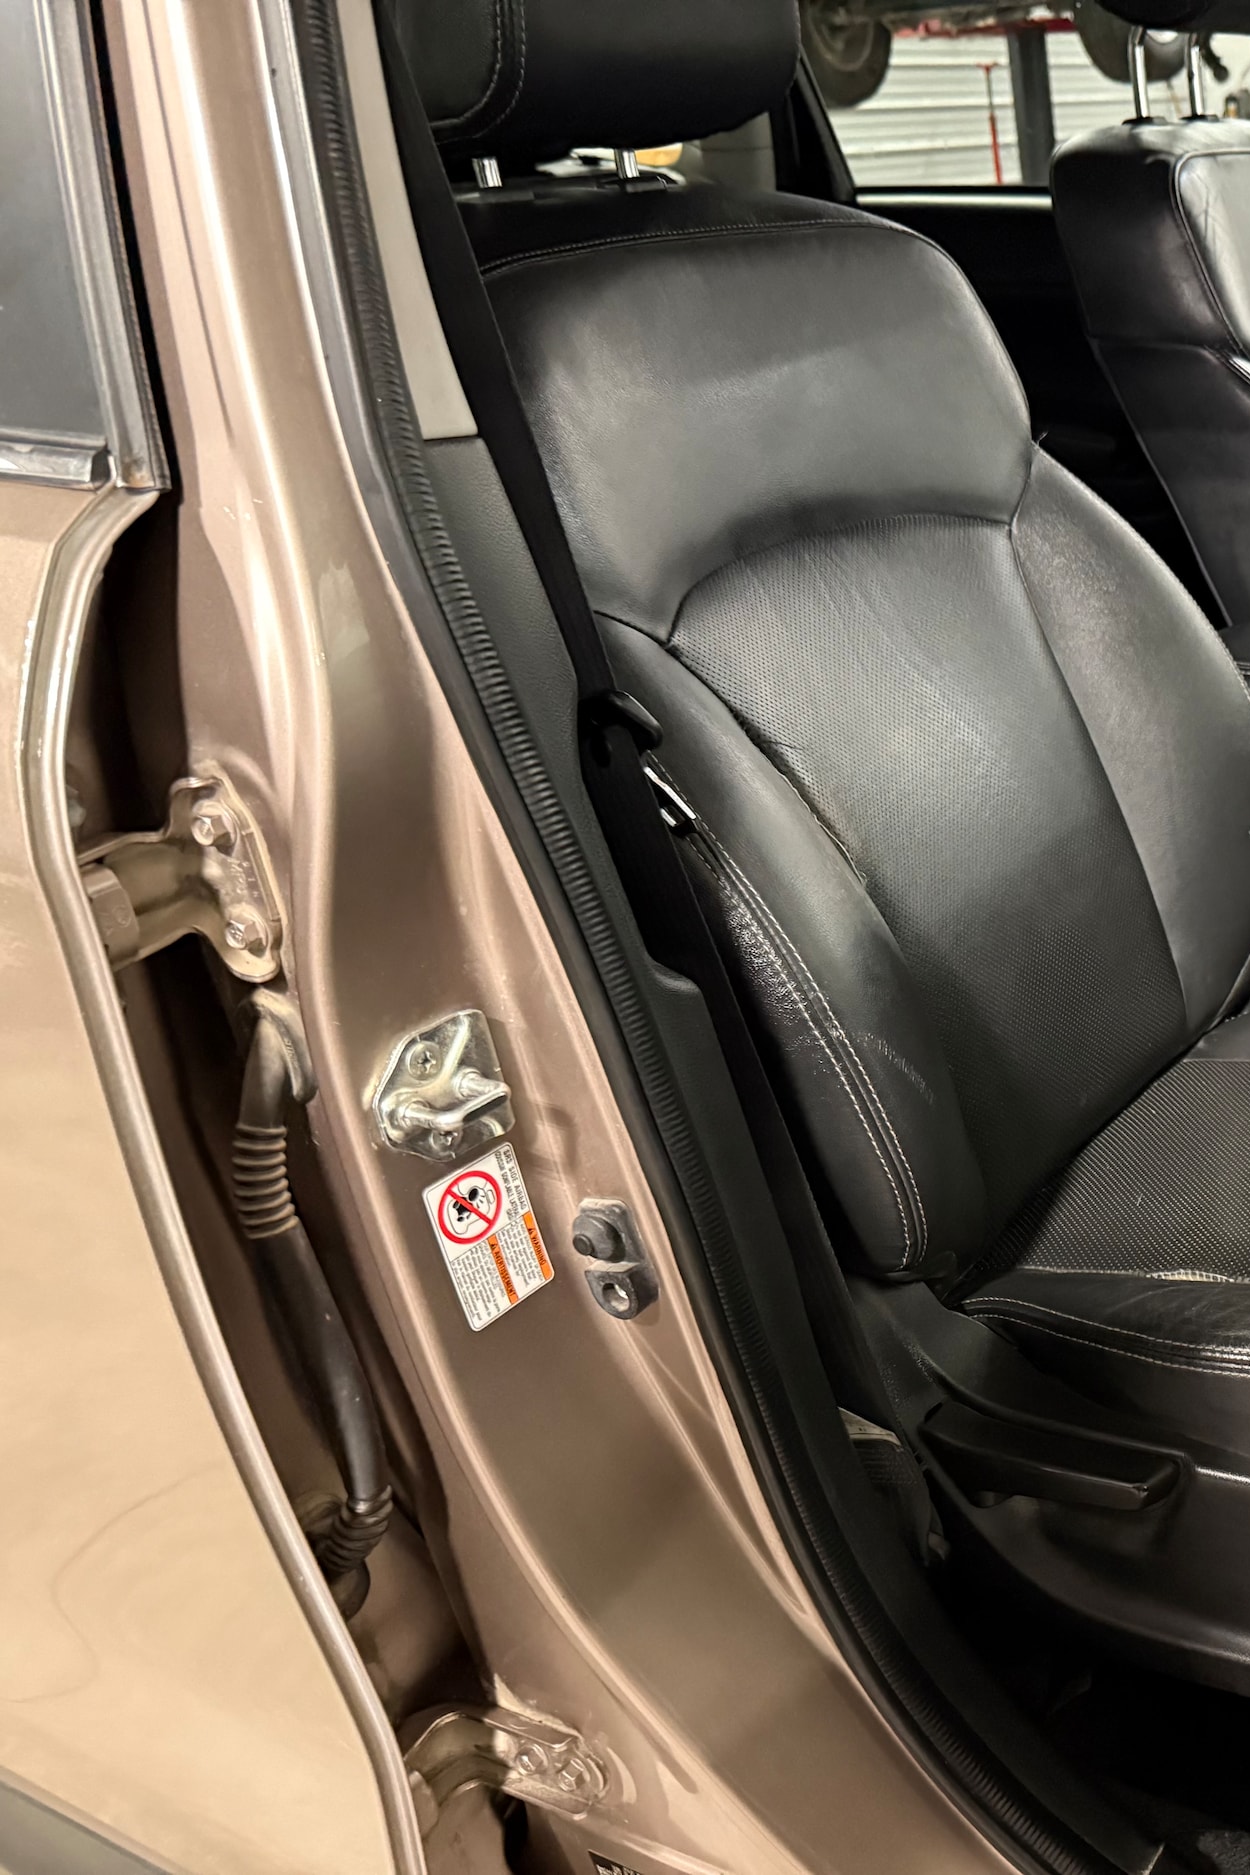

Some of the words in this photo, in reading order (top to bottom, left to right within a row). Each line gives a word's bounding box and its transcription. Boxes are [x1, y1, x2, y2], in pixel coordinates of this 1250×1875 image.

[502, 1147, 513, 1165] SRS
[507, 1164, 519, 1183] SIDE
[513, 1182, 527, 1211] AIRBAG
[530, 1233, 547, 1267] WARNING
[493, 1248, 515, 1298] AVERTISSEMENT
